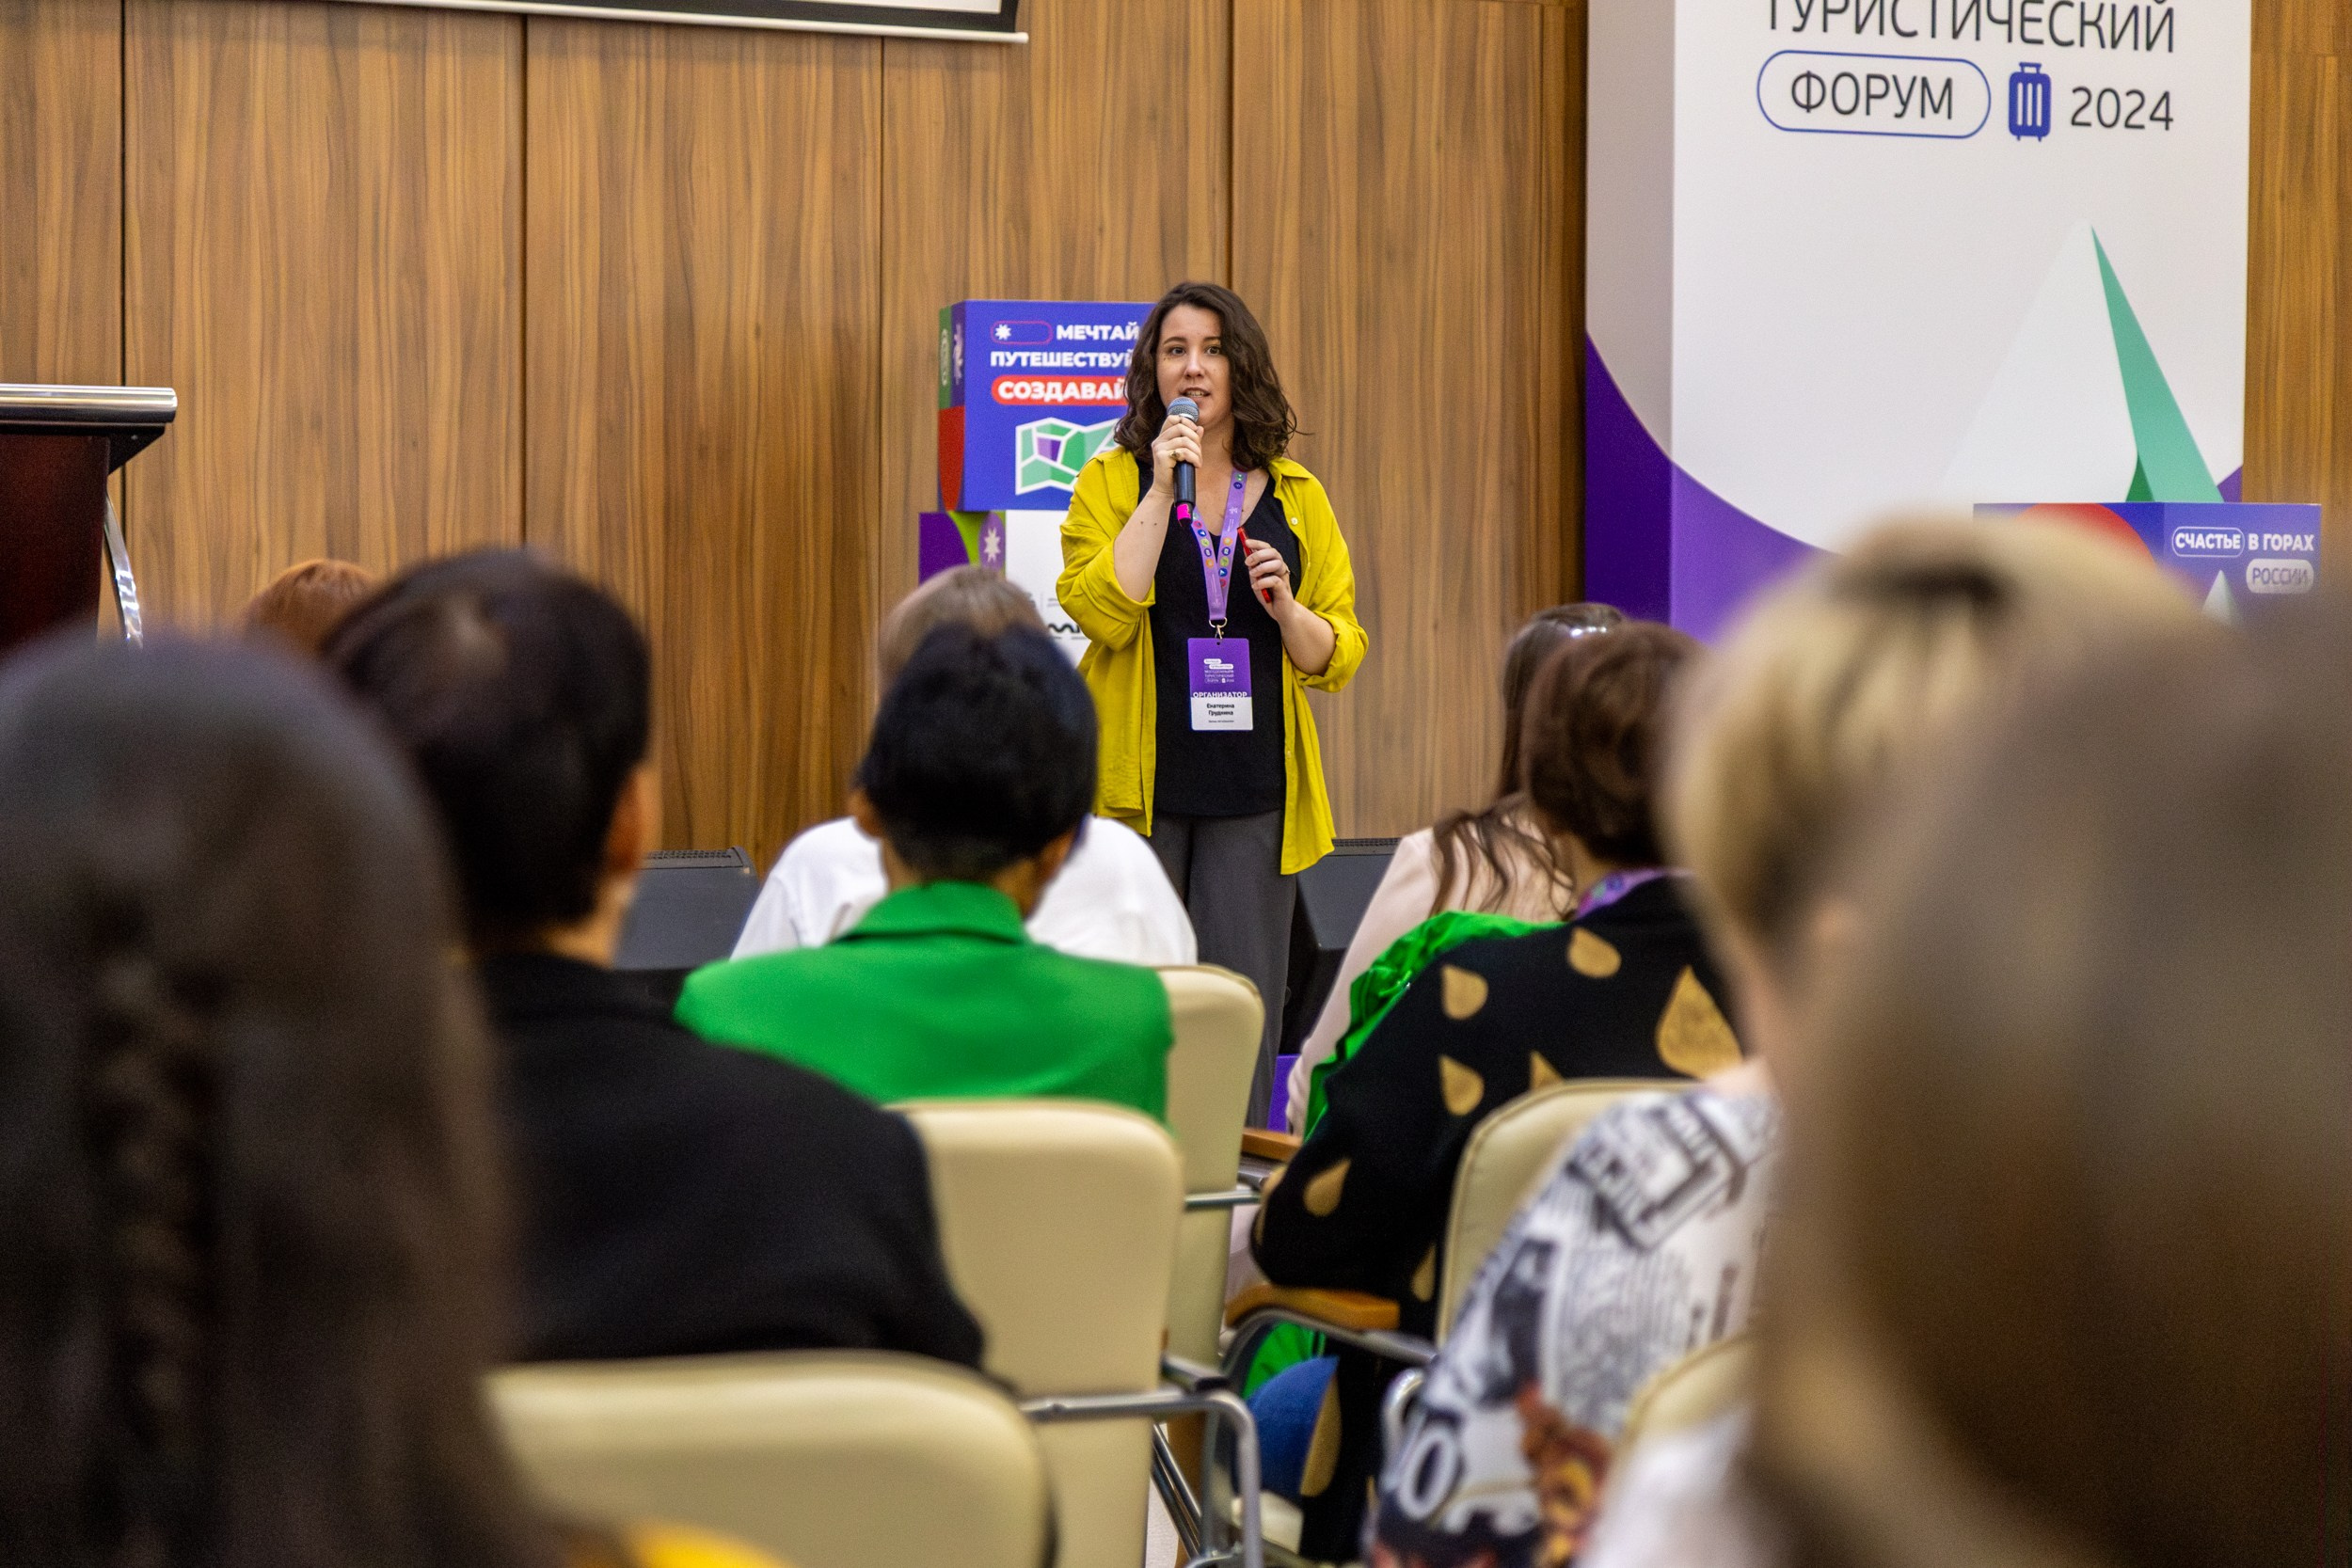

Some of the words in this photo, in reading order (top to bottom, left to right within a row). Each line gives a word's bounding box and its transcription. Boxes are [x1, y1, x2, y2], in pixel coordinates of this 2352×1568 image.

[1790, 71, 1953, 120] ФОРУМ
[2071, 86, 2174, 131] 2024
[1056, 321, 1139, 341] МЕЧТАЙ
[2175, 532, 2241, 549] СЧАСТЬЕ
[2249, 533, 2260, 551] В
[2263, 533, 2314, 551] ГОРАХ
[2252, 567, 2309, 585] РОССИИ
